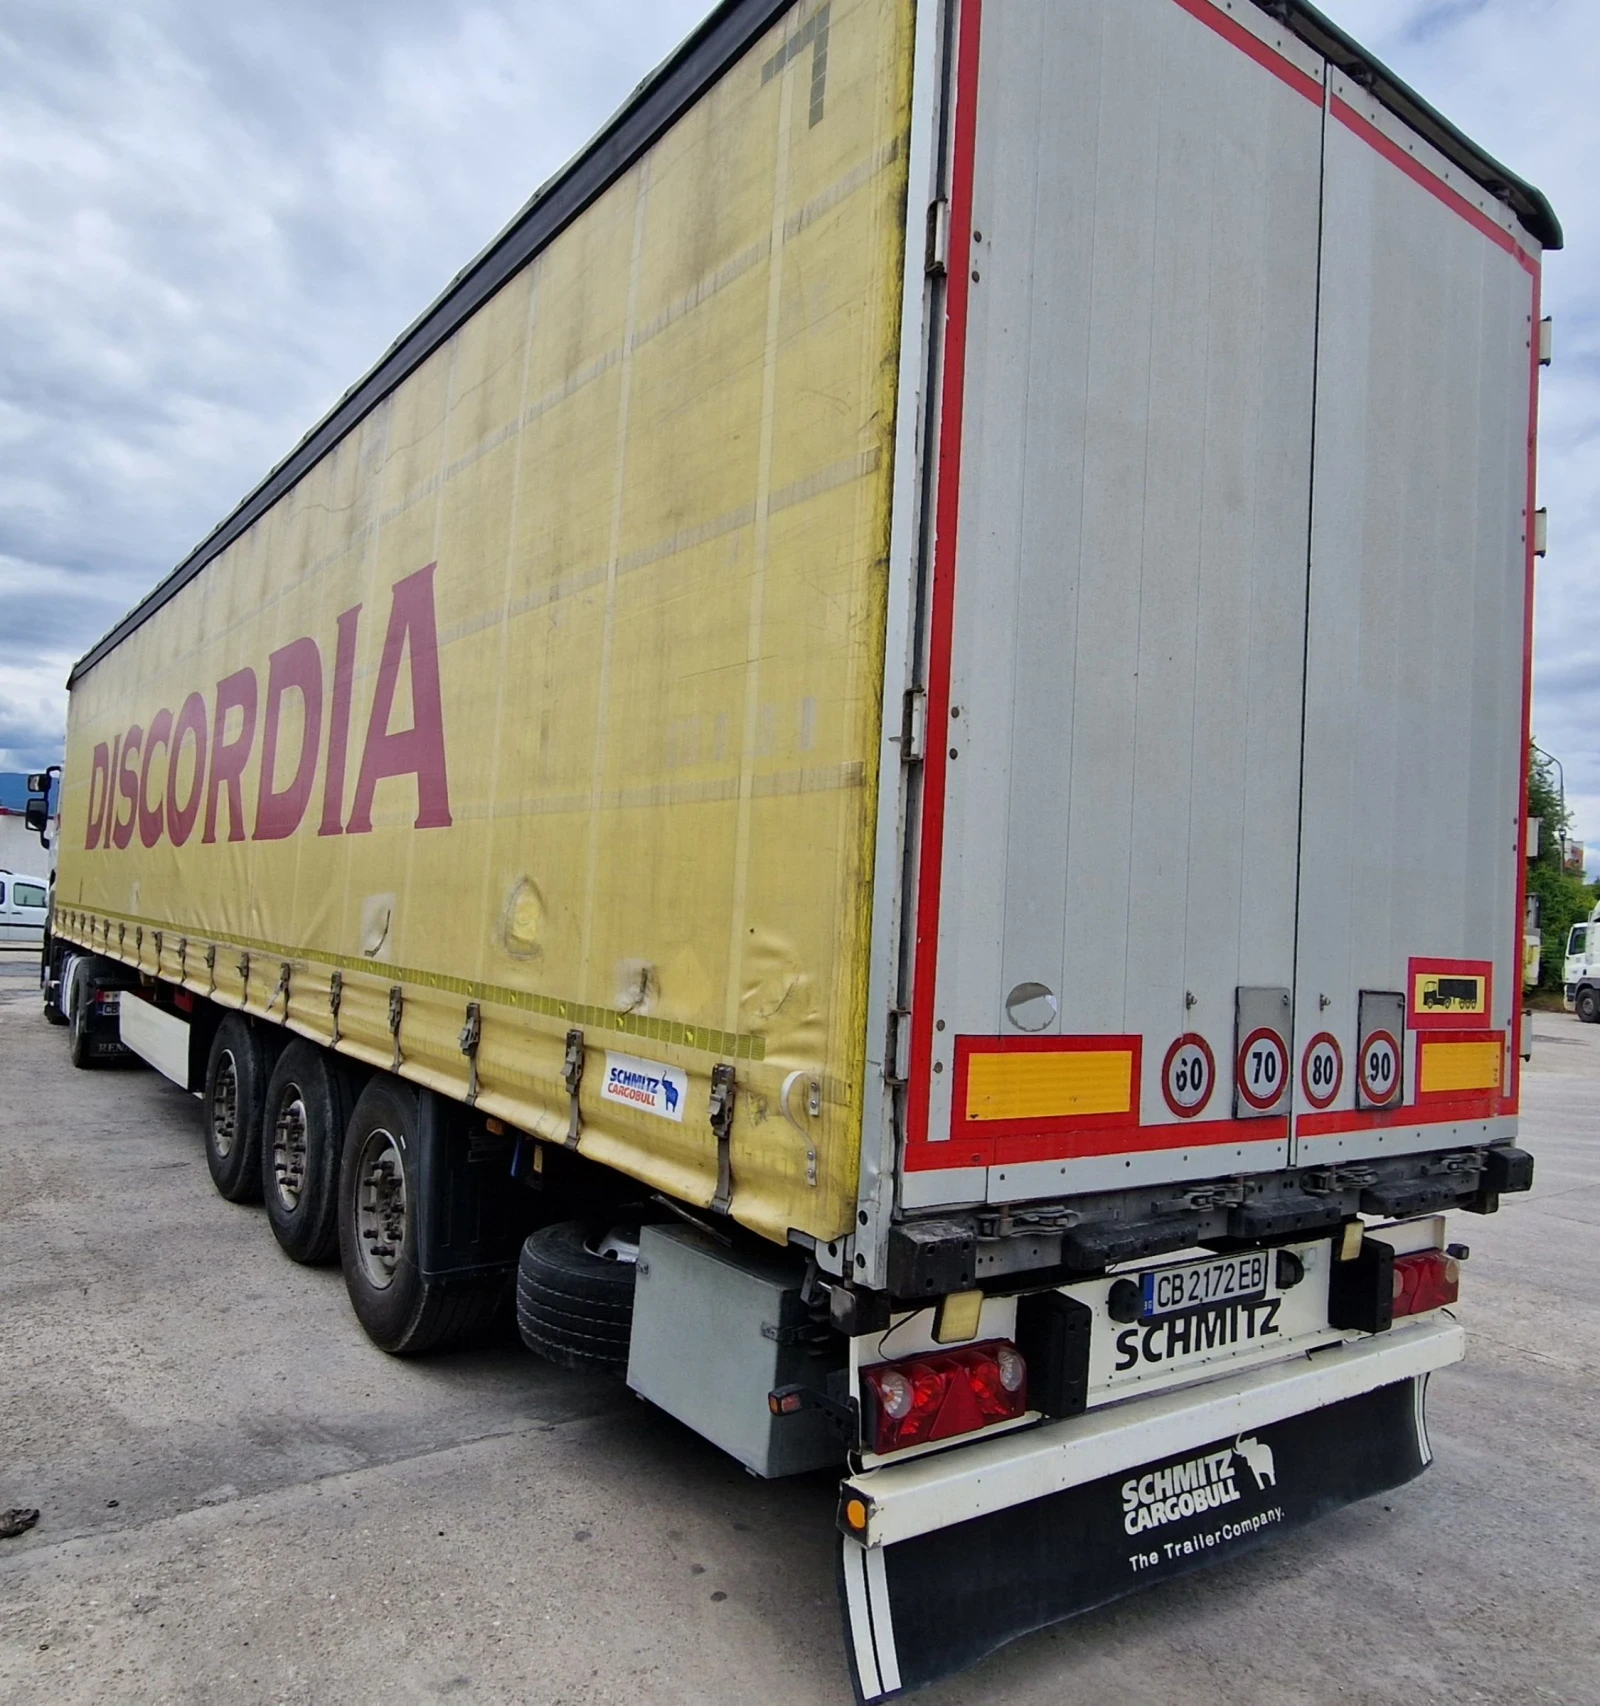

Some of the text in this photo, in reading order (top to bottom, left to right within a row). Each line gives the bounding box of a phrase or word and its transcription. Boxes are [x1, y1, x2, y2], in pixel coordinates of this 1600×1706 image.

[85, 560, 452, 850] DISCORDIA
[609, 1067, 660, 1094] SCHMITZ
[1176, 1057, 1203, 1093] 60
[1252, 1051, 1276, 1084] 70
[1312, 1054, 1333, 1085] 80
[1369, 1052, 1391, 1082] 90
[607, 1083, 656, 1107] CARGOBULL
[1115, 1298, 1281, 1371] SCHMITZ
[1121, 1447, 1236, 1512] SCHMITZ
[1124, 1478, 1241, 1535] CARGOBULL
[1129, 1551, 1159, 1572] The
